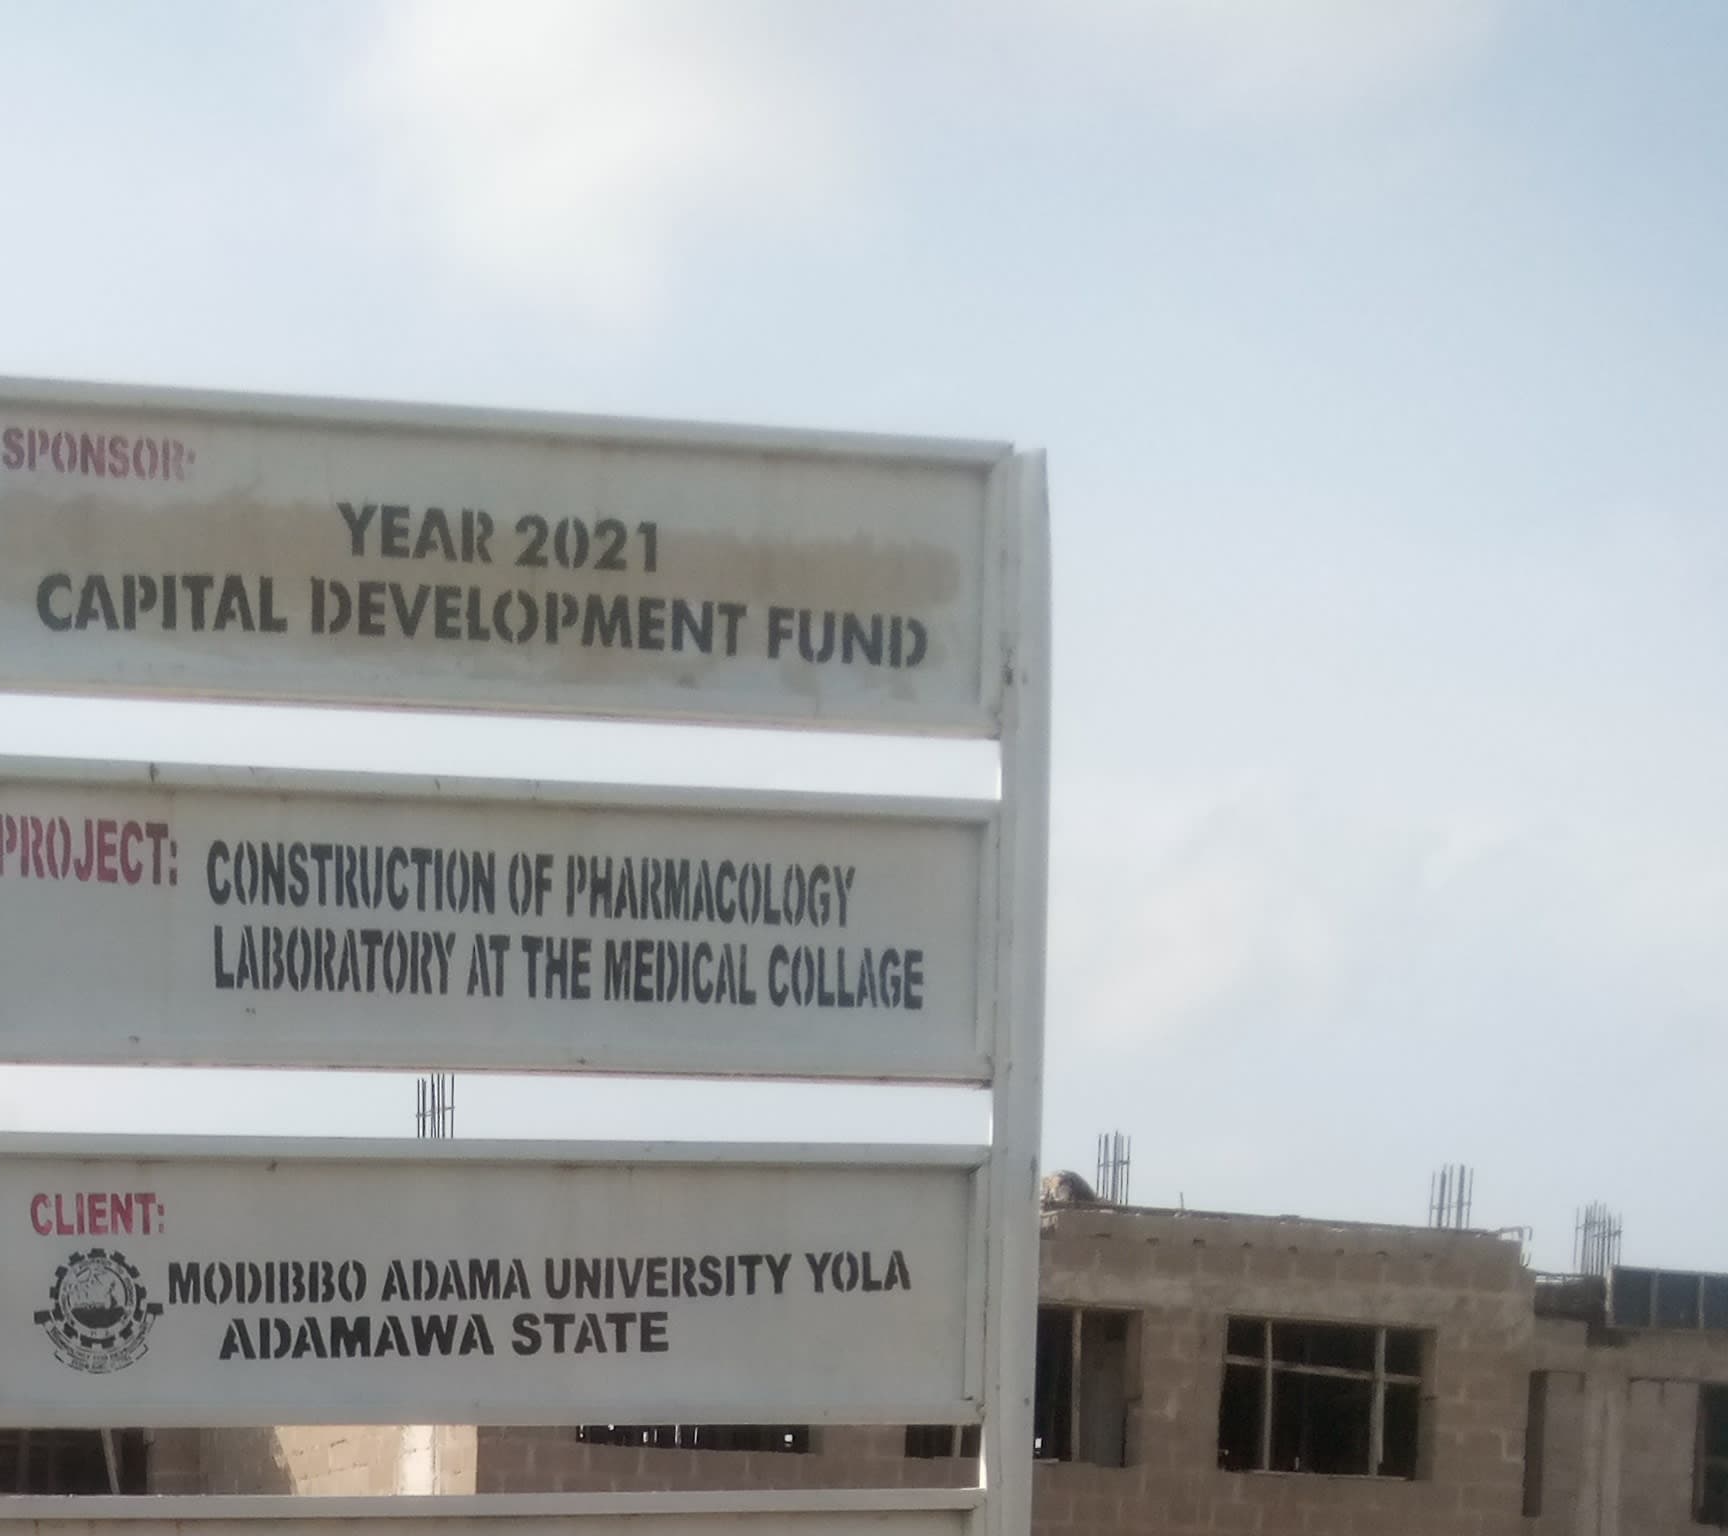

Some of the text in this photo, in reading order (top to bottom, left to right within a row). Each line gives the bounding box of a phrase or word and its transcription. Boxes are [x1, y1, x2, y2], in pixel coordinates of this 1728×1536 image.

[337, 502, 662, 572] YEAR 2021
[36, 573, 927, 669] CAPITAL DEVELOPMENT FUND
[207, 840, 495, 912] CONSTRUCTION
[509, 854, 553, 917] OF
[566, 854, 855, 927] PHARMACOLOGY
[214, 926, 923, 1009] LABORATORY AT THE MEDICAL COLLAGE
[31, 1193, 165, 1237] CLIENT:
[168, 1258, 366, 1304] MODIBBO
[382, 1258, 531, 1301] ADAMA
[545, 1253, 791, 1300] UNIVERSITY
[805, 1250, 911, 1293] YOLA
[219, 1311, 670, 1360] ADAMAWA STATE
